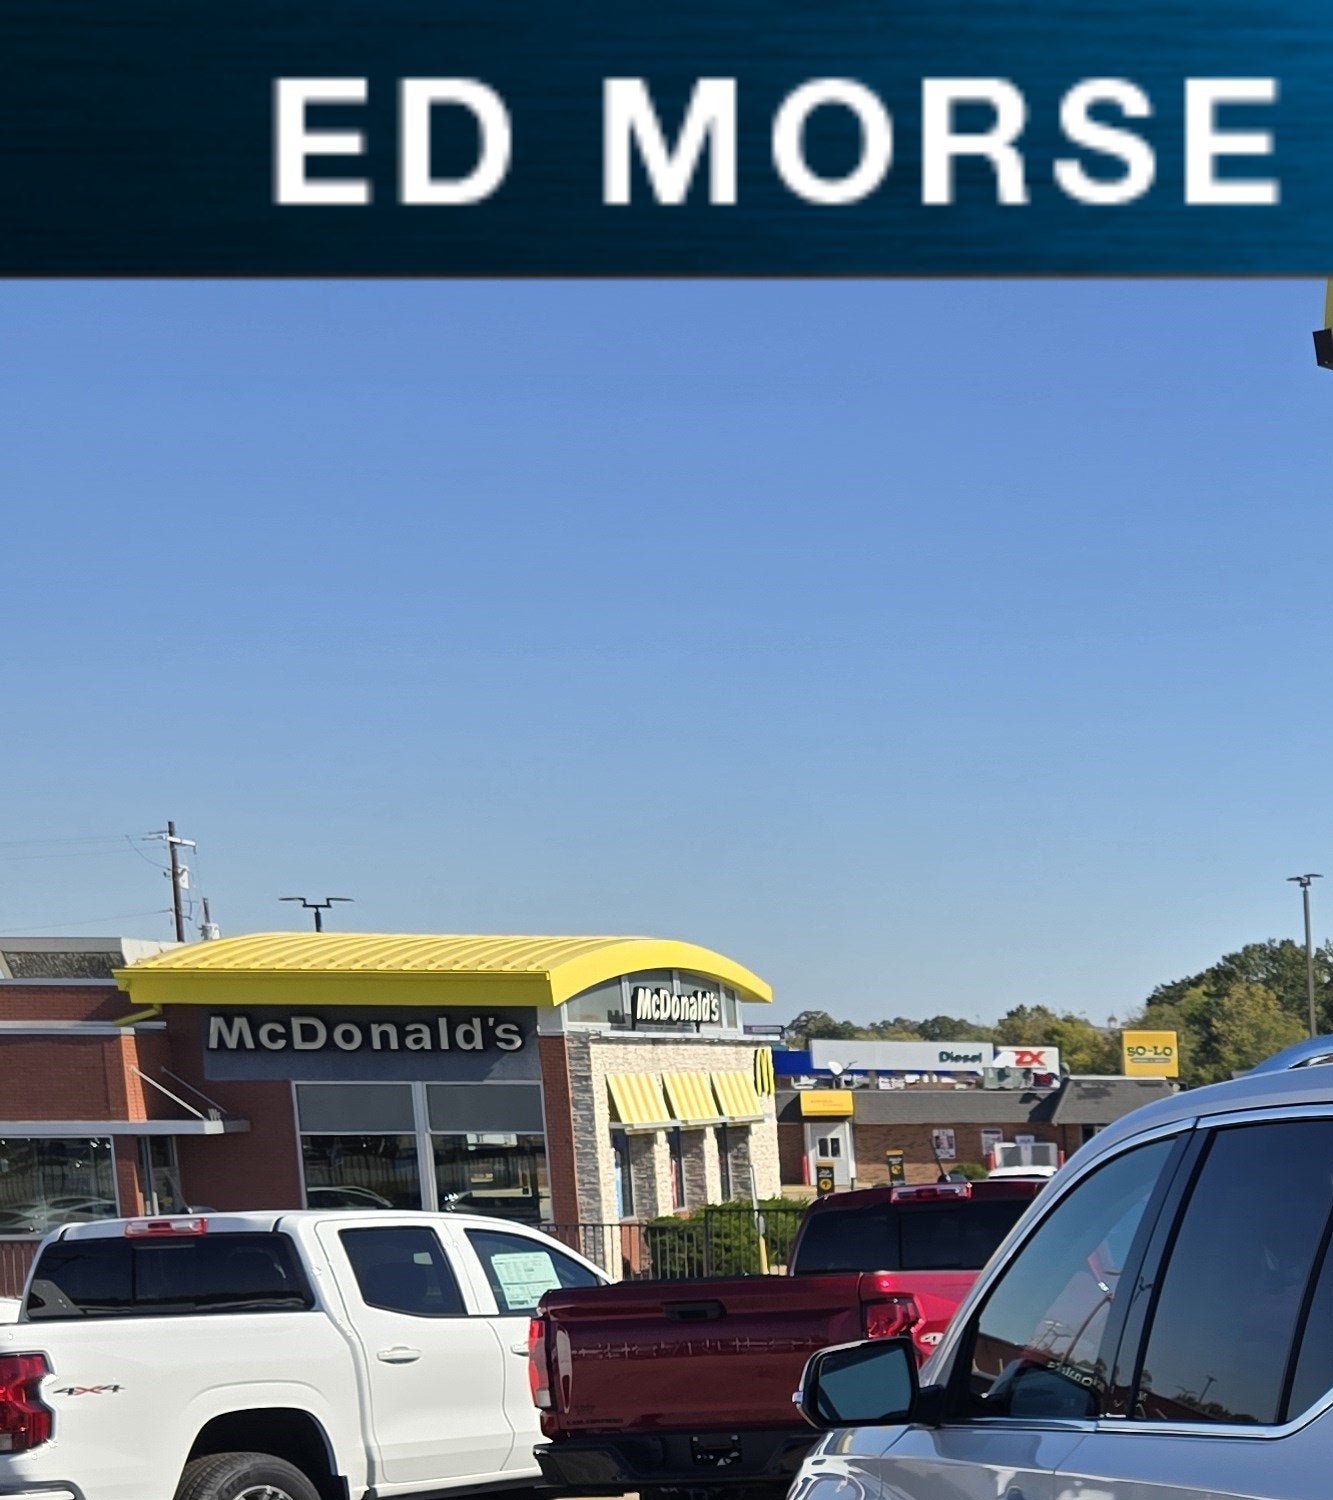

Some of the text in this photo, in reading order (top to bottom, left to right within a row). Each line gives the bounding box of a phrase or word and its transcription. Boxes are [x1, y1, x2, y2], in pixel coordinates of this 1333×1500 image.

[636, 986, 720, 1023] McDonald's
[208, 1016, 523, 1051] McDonald's
[939, 1051, 982, 1063] Diesel
[1127, 1045, 1172, 1057] SO-LO
